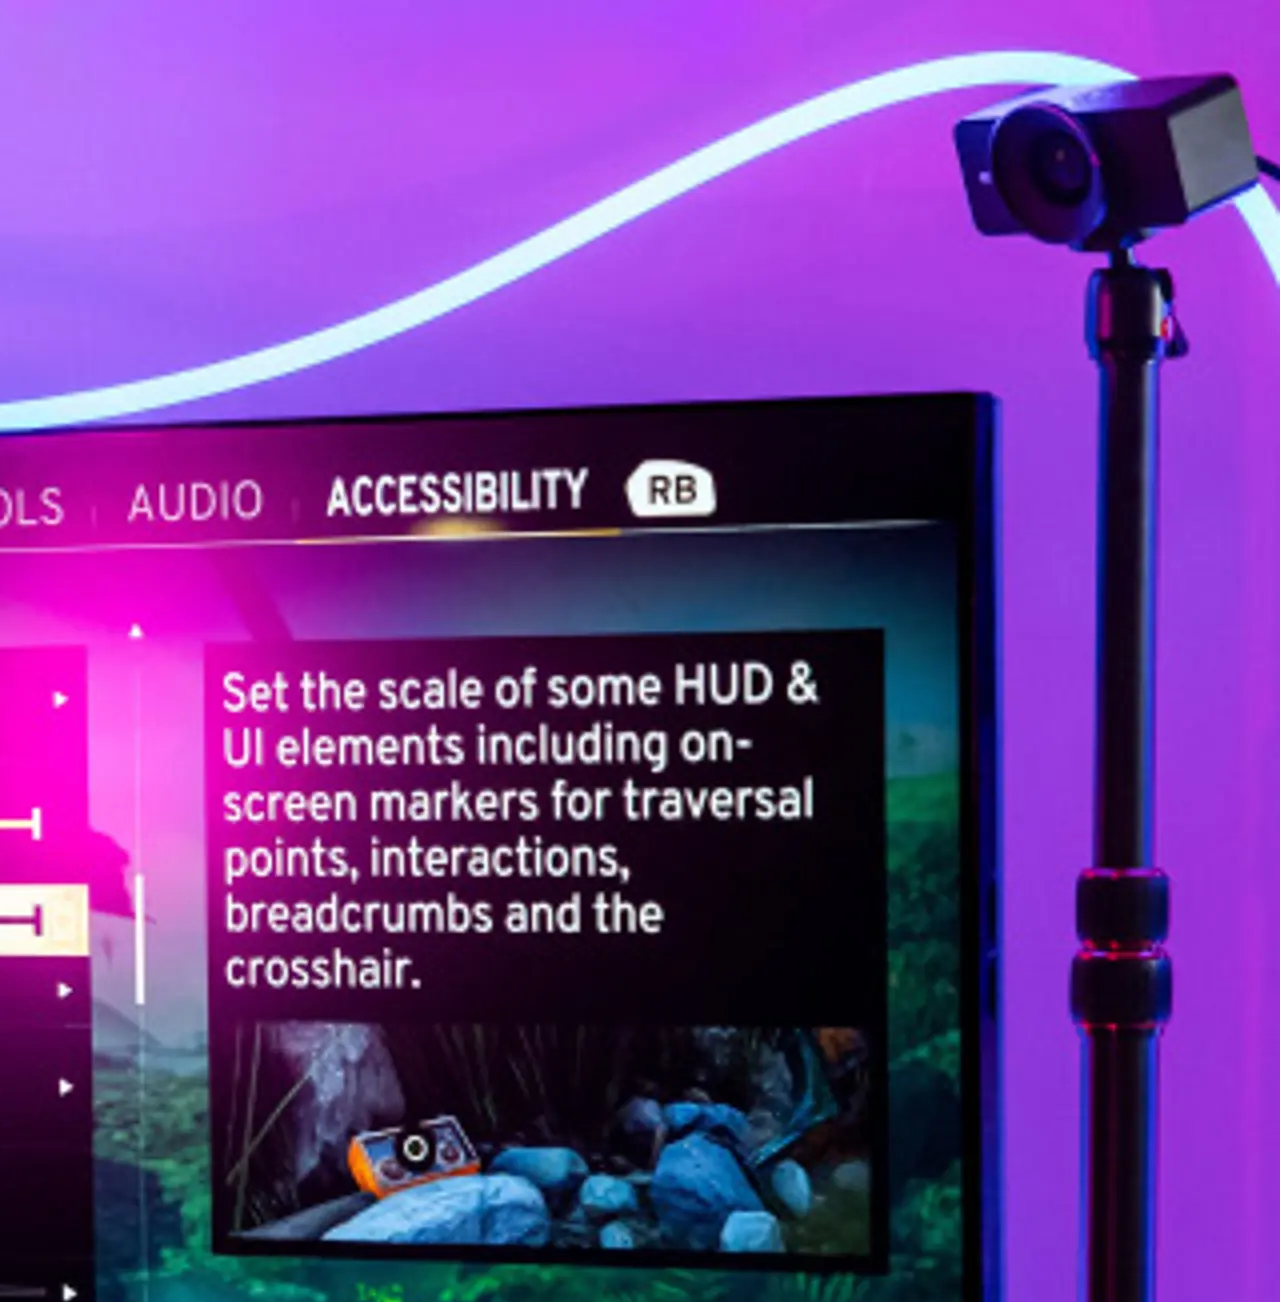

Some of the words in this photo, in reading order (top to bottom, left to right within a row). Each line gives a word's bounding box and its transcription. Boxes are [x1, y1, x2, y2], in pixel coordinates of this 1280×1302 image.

[128, 480, 263, 521] AUDIO
[328, 469, 589, 516] ACCESSIBILITY
[649, 475, 697, 504] RB
[222, 672, 289, 713] Set
[301, 673, 366, 711] the
[379, 668, 484, 710] scale
[495, 666, 537, 709] of
[547, 673, 662, 709] some
[675, 662, 773, 705] HUD
[786, 661, 820, 704] &
[223, 727, 263, 768] UI
[276, 724, 465, 767] elements
[477, 722, 667, 773] including
[680, 730, 753, 764] on-
[223, 789, 357, 823] screen
[370, 781, 539, 822] markers
[550, 778, 612, 821] for
[623, 776, 814, 821] traversal
[225, 836, 360, 885] points,
[371, 835, 631, 884] interactions,
[225, 892, 493, 934] breadcrumbs
[504, 893, 582, 934] and
[593, 893, 665, 934] the
[225, 948, 422, 990] crosshair.
